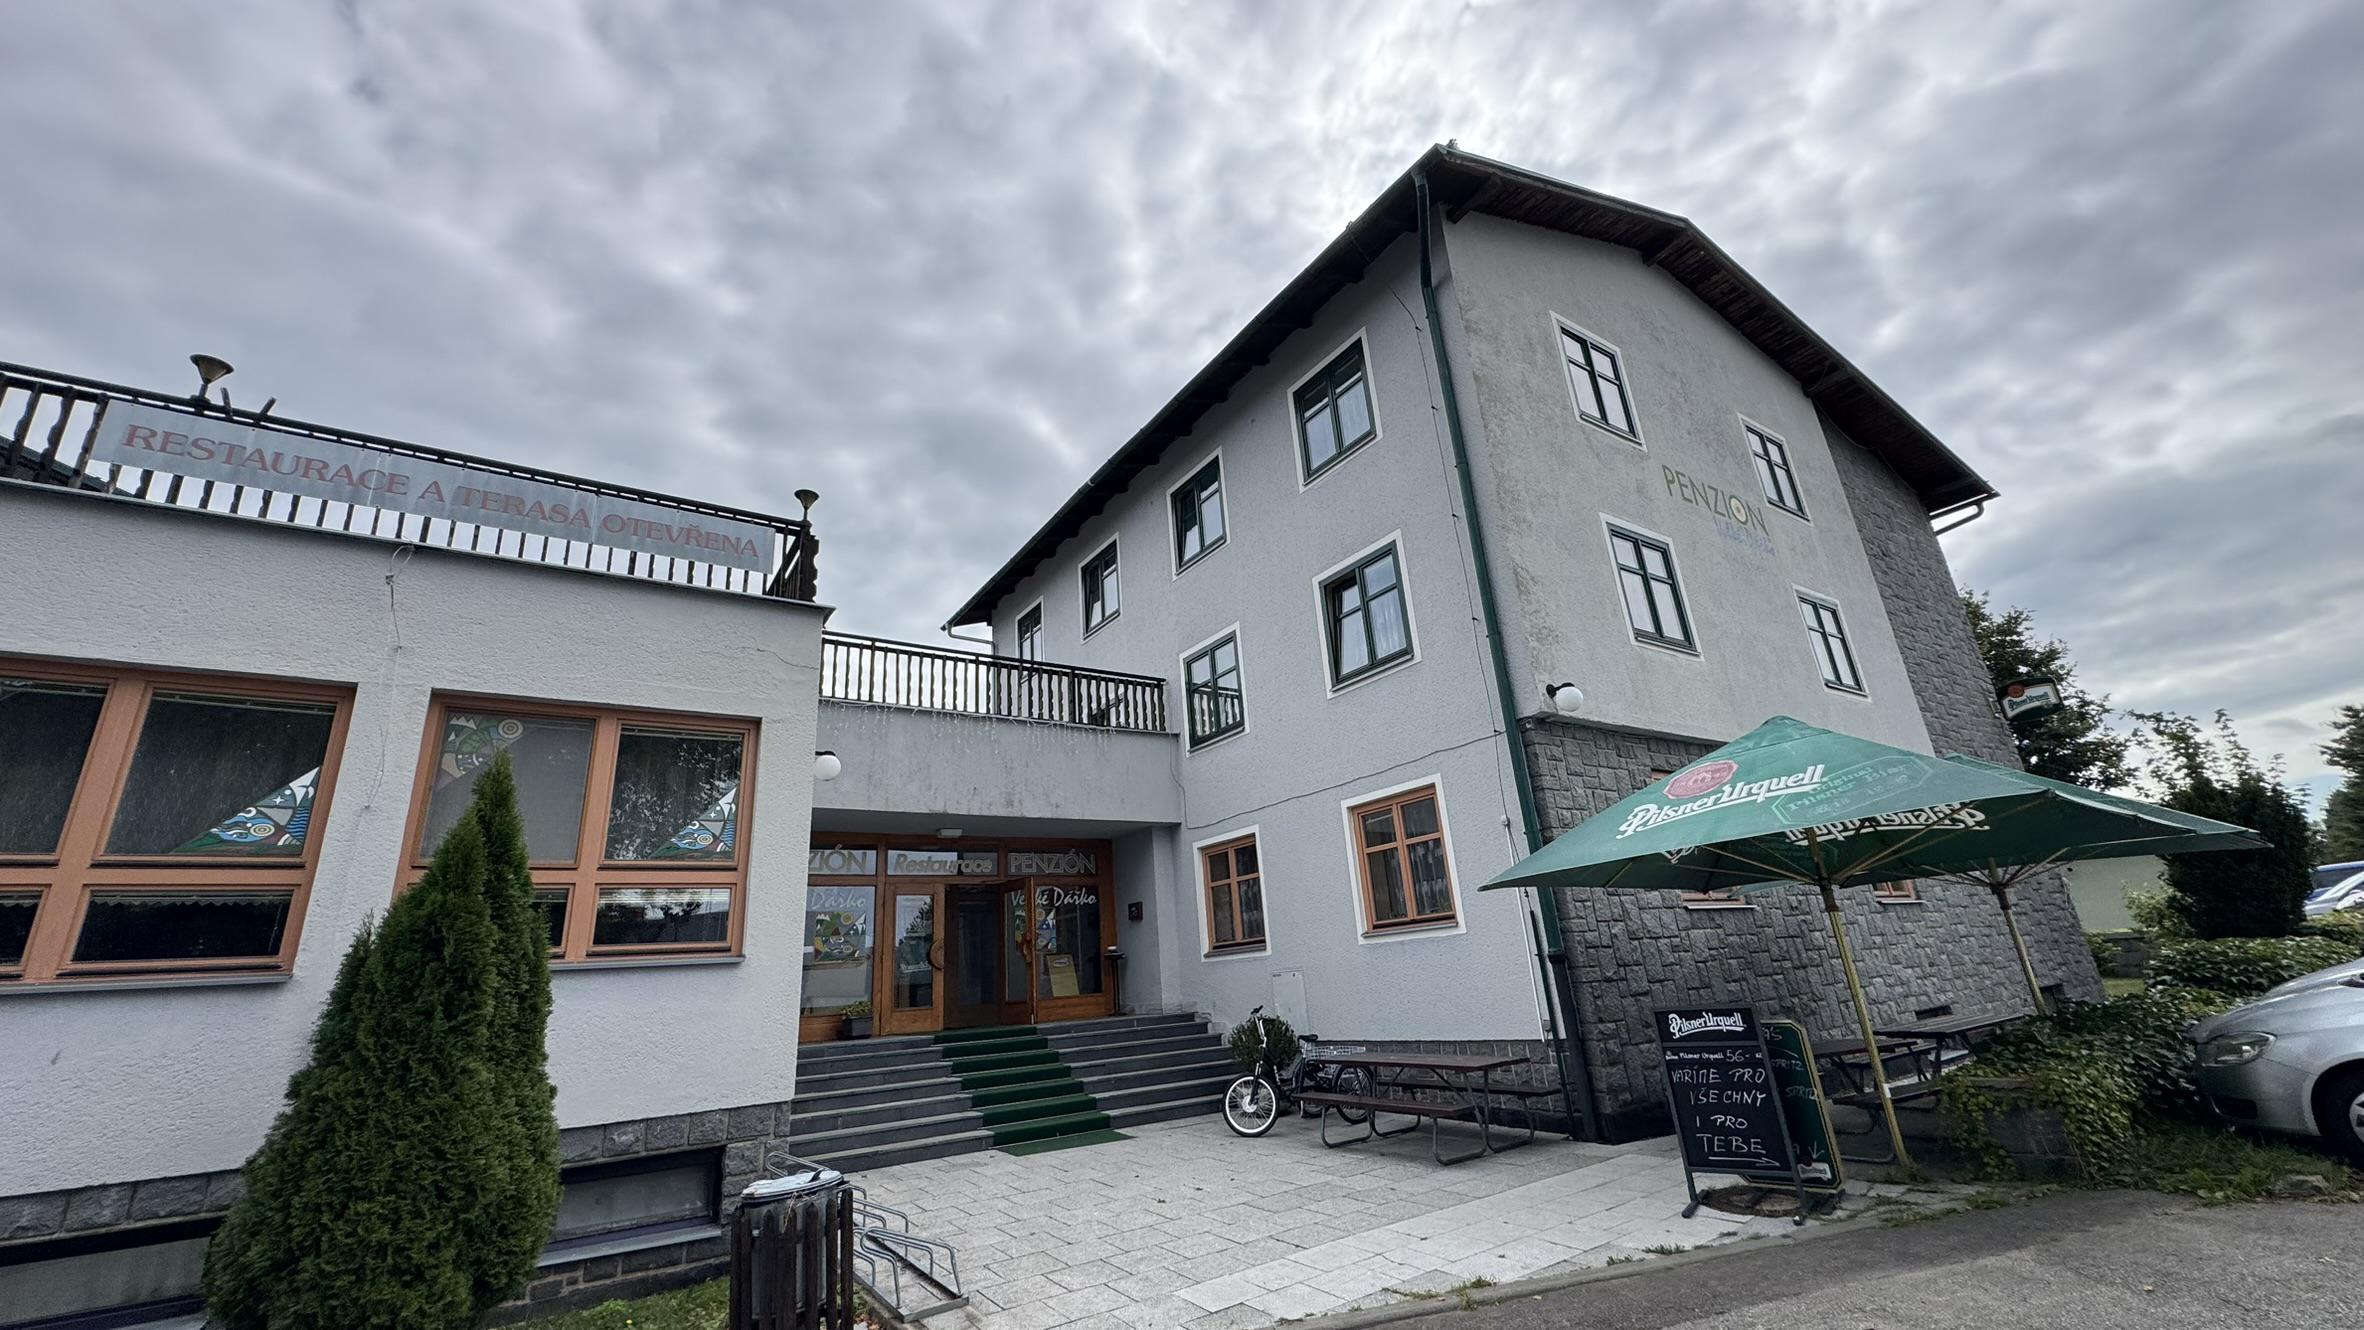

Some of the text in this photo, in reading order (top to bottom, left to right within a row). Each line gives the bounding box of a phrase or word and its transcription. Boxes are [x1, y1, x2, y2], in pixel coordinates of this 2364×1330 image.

[122, 424, 758, 558] RESTAURACE A TERASA OTEVŘENA
[1662, 464, 1769, 537] PENZION
[1616, 793, 1722, 839] Pilsner
[1719, 764, 1825, 803] Urquell
[1010, 848, 1096, 874] PENZIÓN
[1011, 887, 1050, 907] Veké
[1668, 1011, 1744, 1039] Pilsner Urquell
[1729, 1068, 1765, 1083] PRO
[1696, 1115, 1748, 1128] I PRO
[1696, 1134, 1766, 1154] TEBE
